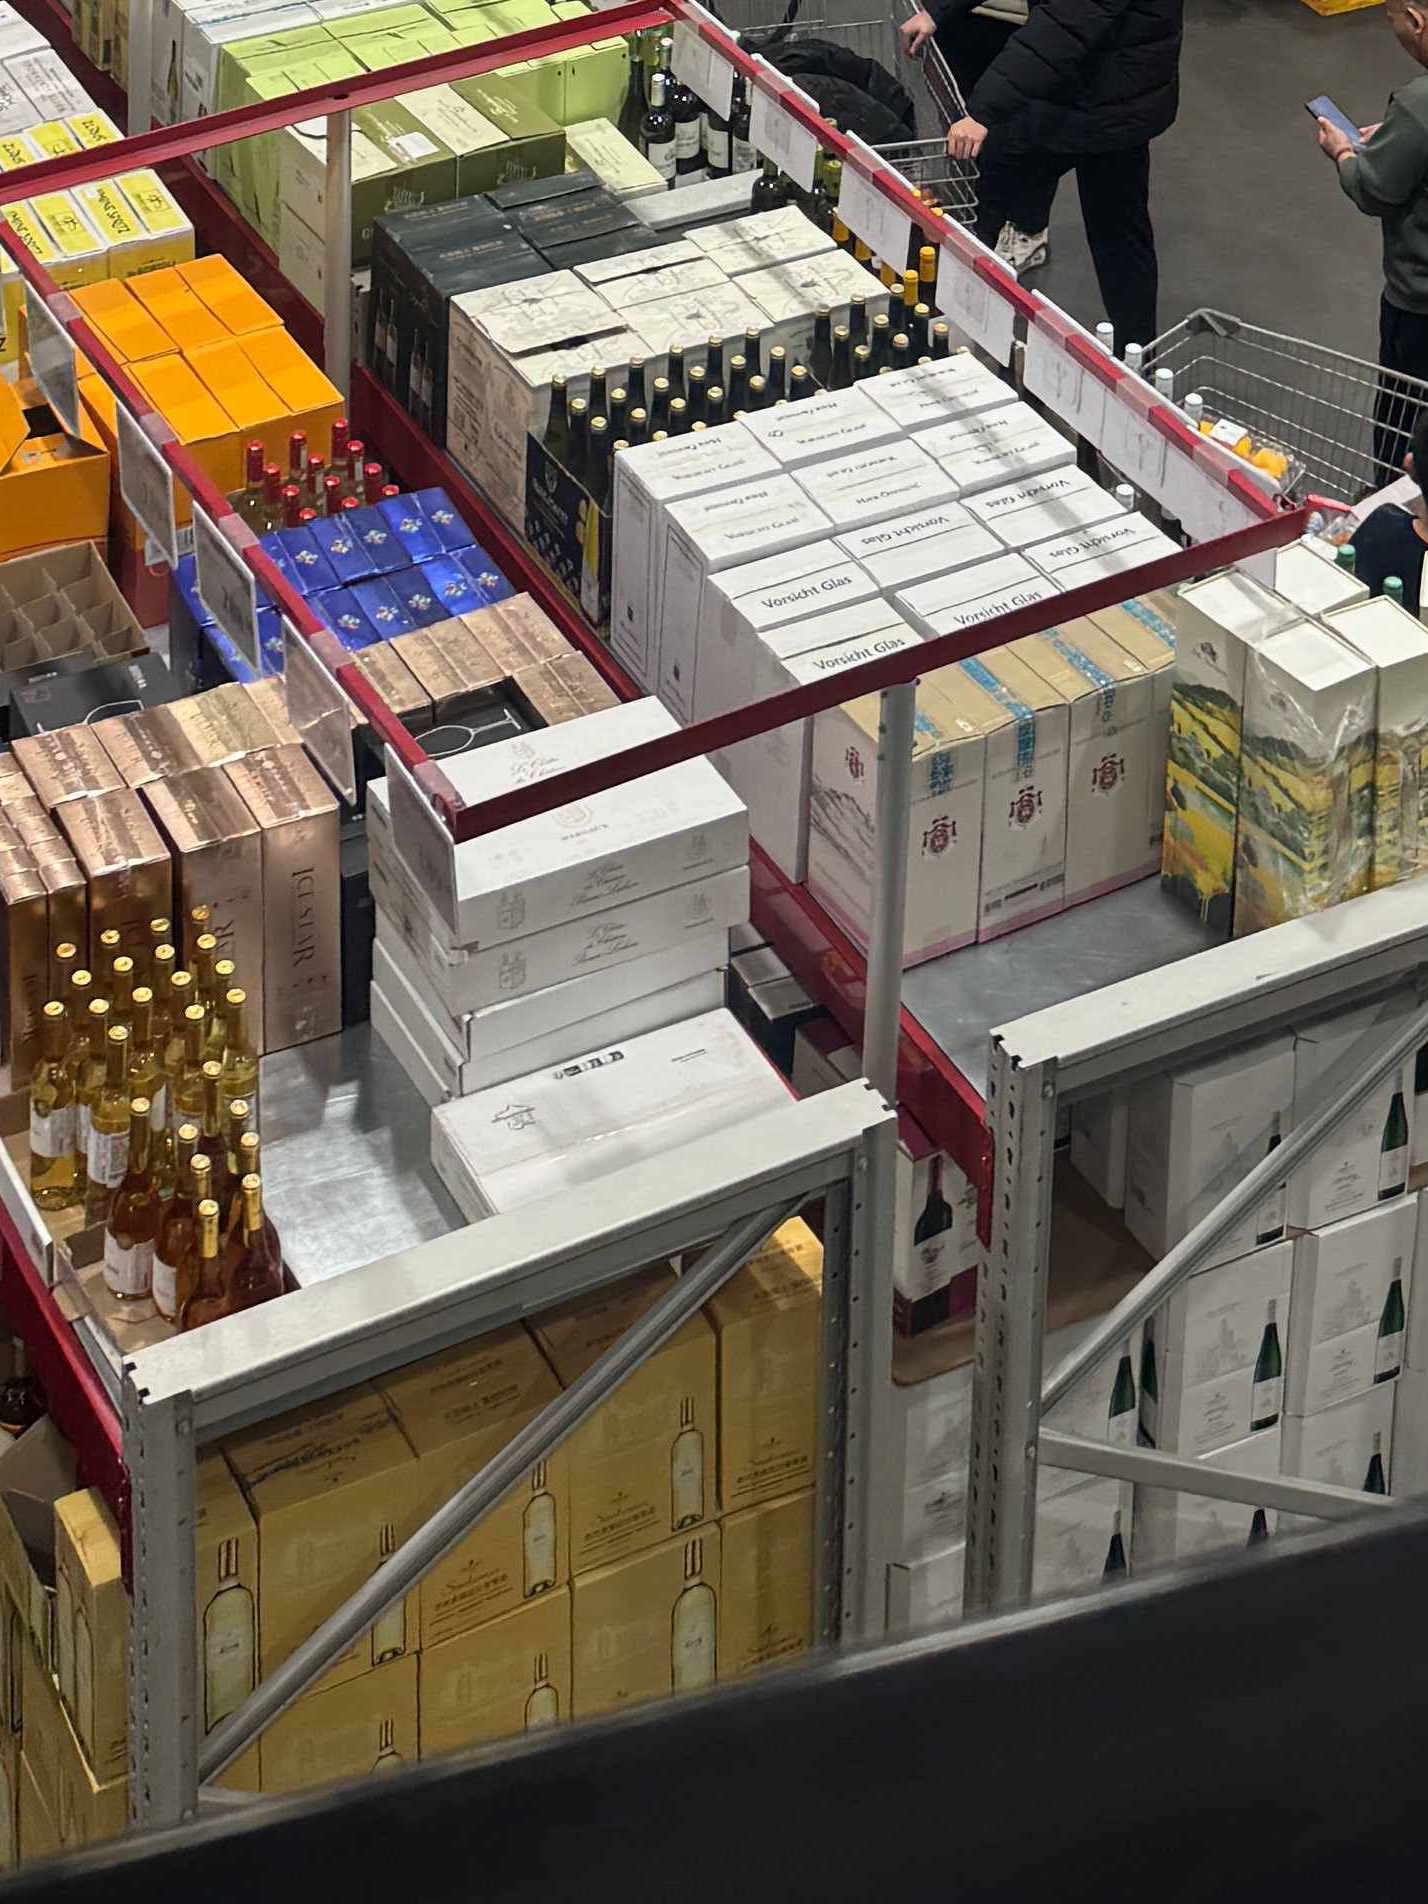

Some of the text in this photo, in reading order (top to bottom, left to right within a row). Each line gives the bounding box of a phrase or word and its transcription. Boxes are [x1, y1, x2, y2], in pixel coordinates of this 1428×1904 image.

[860, 513, 951, 546] Vorsicht Glas
[761, 574, 854, 609] Vorsicht Glas
[953, 590, 1043, 627] Vorsicht Glas
[812, 636, 907, 671] Vorsicht Glas
